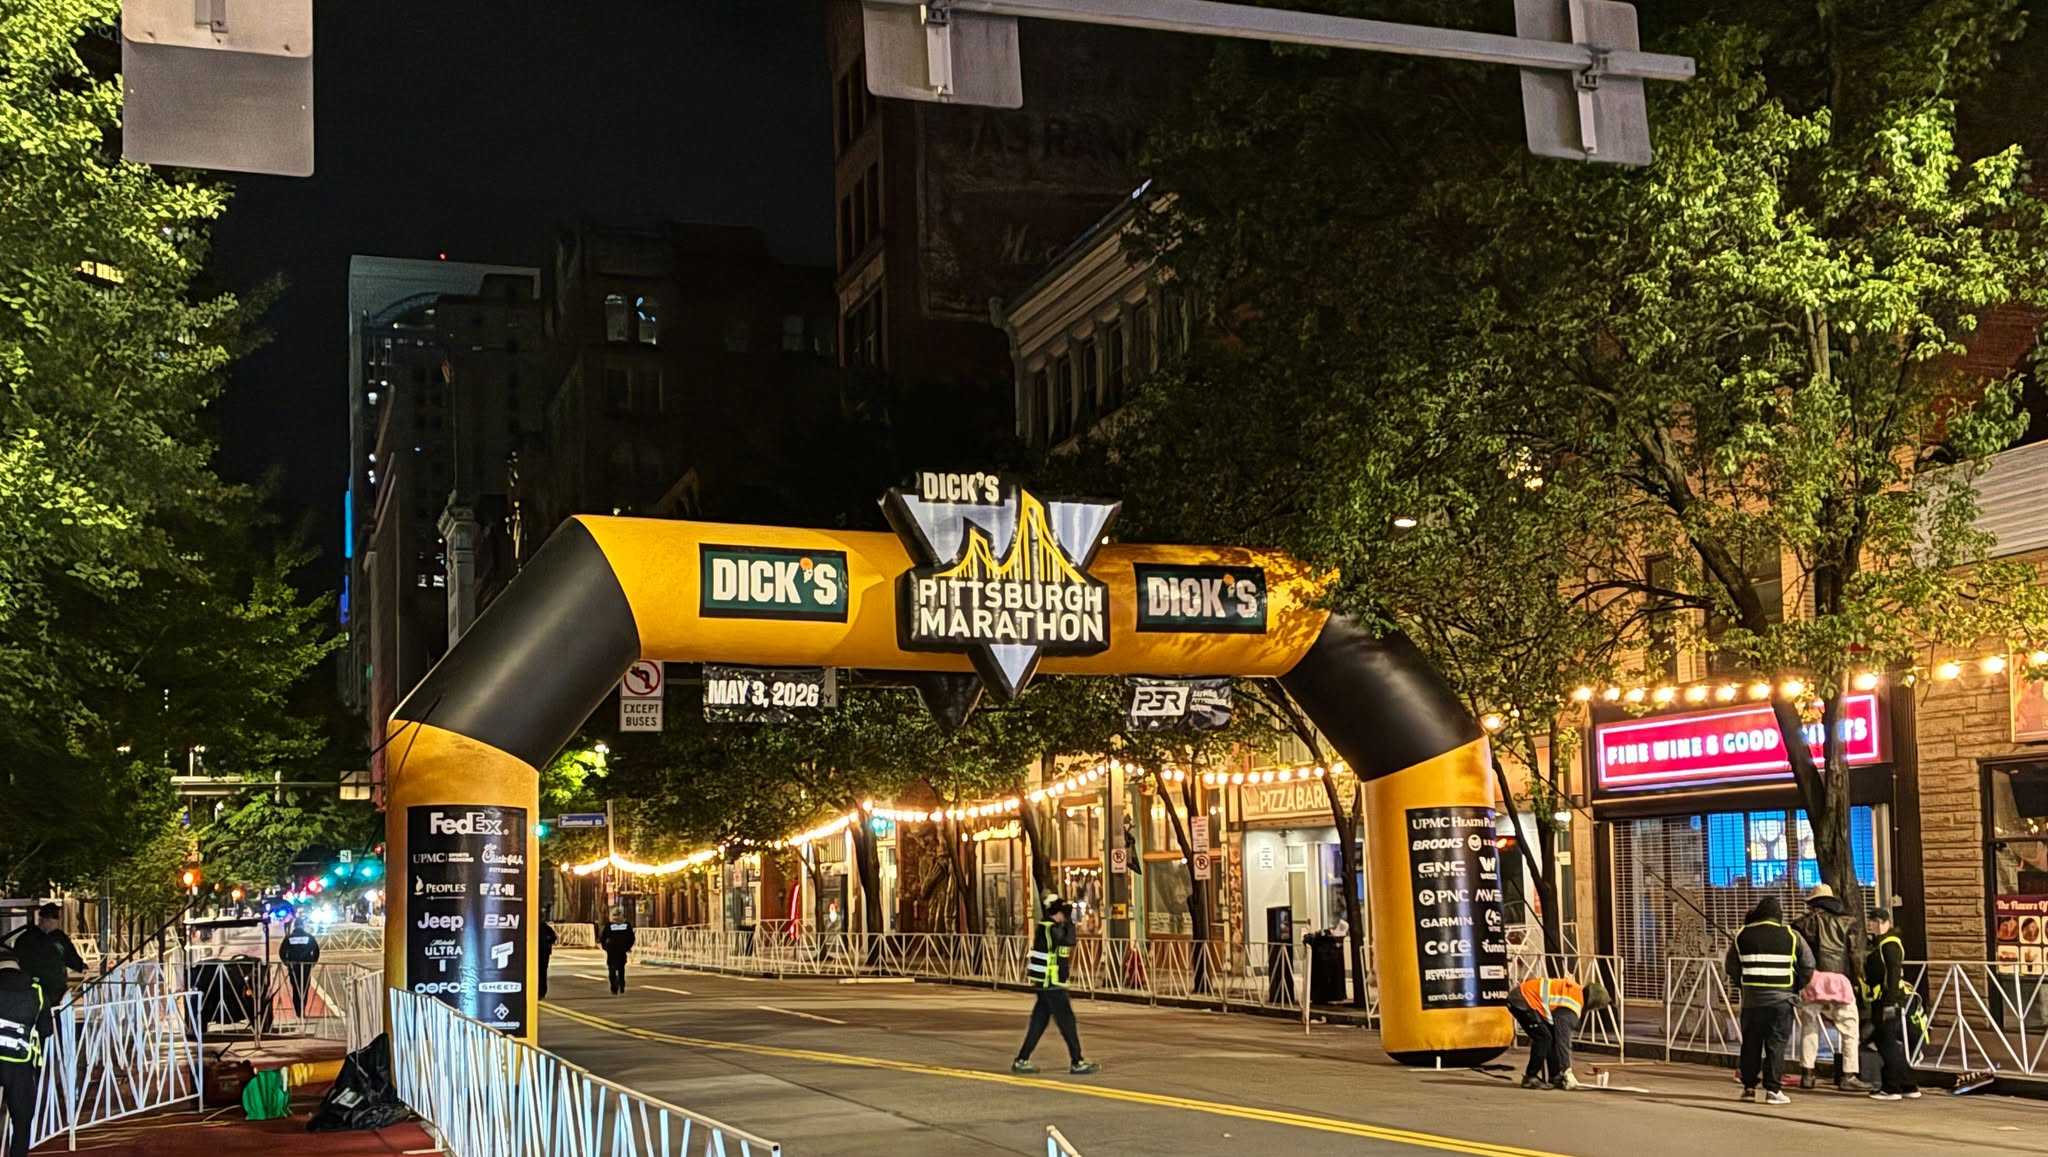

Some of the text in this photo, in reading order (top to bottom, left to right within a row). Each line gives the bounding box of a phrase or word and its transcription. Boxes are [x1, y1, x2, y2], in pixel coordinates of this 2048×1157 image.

[923, 472, 999, 502] DICK'S
[712, 557, 838, 606] DICK'S
[919, 579, 1102, 612] PITTSBURGH
[1147, 575, 1258, 618] DICK'S
[920, 607, 1104, 642] MARATHON
[708, 680, 819, 708] MAY 3, 2026
[624, 703, 659, 714] EXCEPT
[625, 716, 657, 727] BUSES
[1607, 743, 1649, 766] FINE
[1653, 737, 1703, 761] WINE
[1723, 728, 1779, 754] GOOD
[1412, 816, 1450, 830] UPMC
[1412, 837, 1465, 851] BROOKS
[412, 852, 445, 864] UPMC
[1418, 861, 1467, 874] GNC
[426, 883, 466, 894] PEOPLES
[1436, 888, 1470, 903] PNC
[417, 912, 464, 932] Jeep
[1420, 916, 1474, 929] GARMIN
[424, 946, 463, 956] ULTRA
